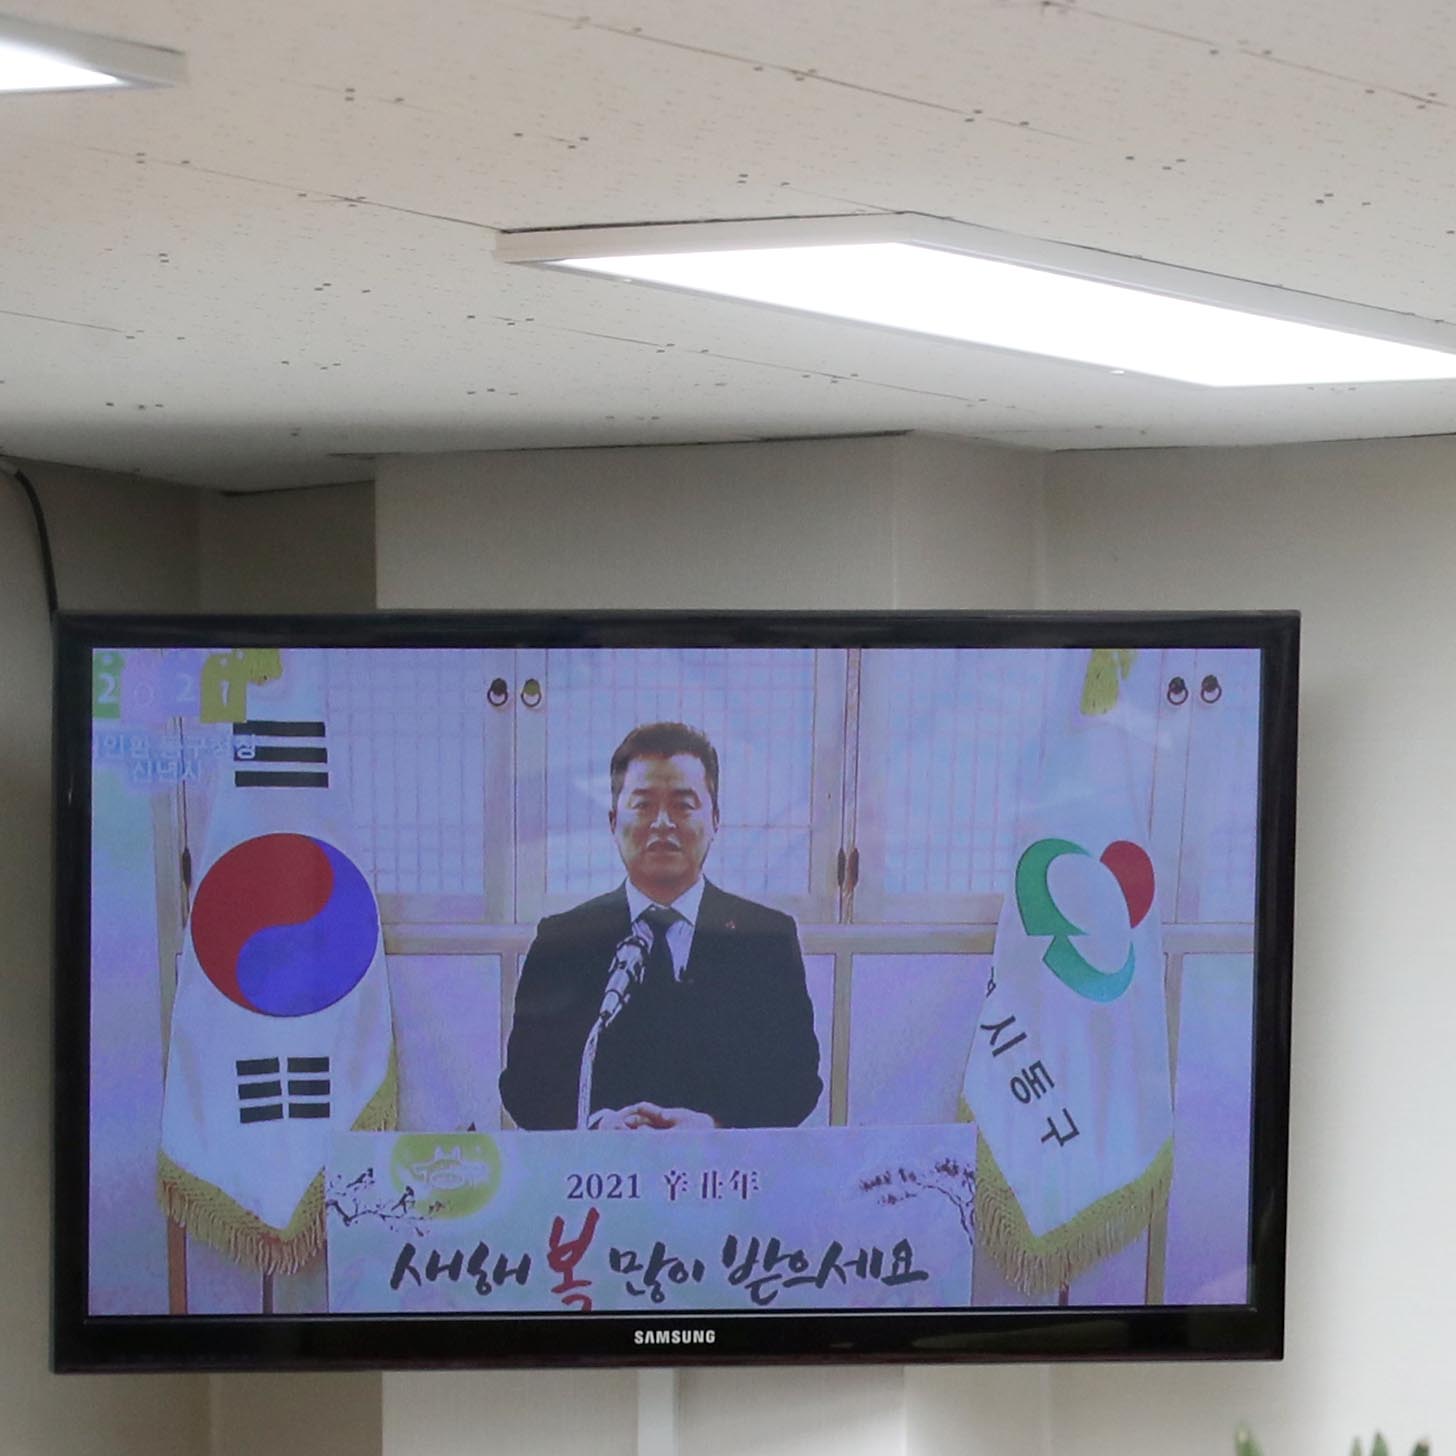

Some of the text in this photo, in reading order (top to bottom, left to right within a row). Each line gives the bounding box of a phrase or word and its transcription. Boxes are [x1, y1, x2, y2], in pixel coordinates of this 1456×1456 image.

[567, 1173, 641, 1200] 2021
[390, 1206, 929, 1312] 새해 복 많이 받으세요
[633, 1329, 716, 1345] SAMSUNG
